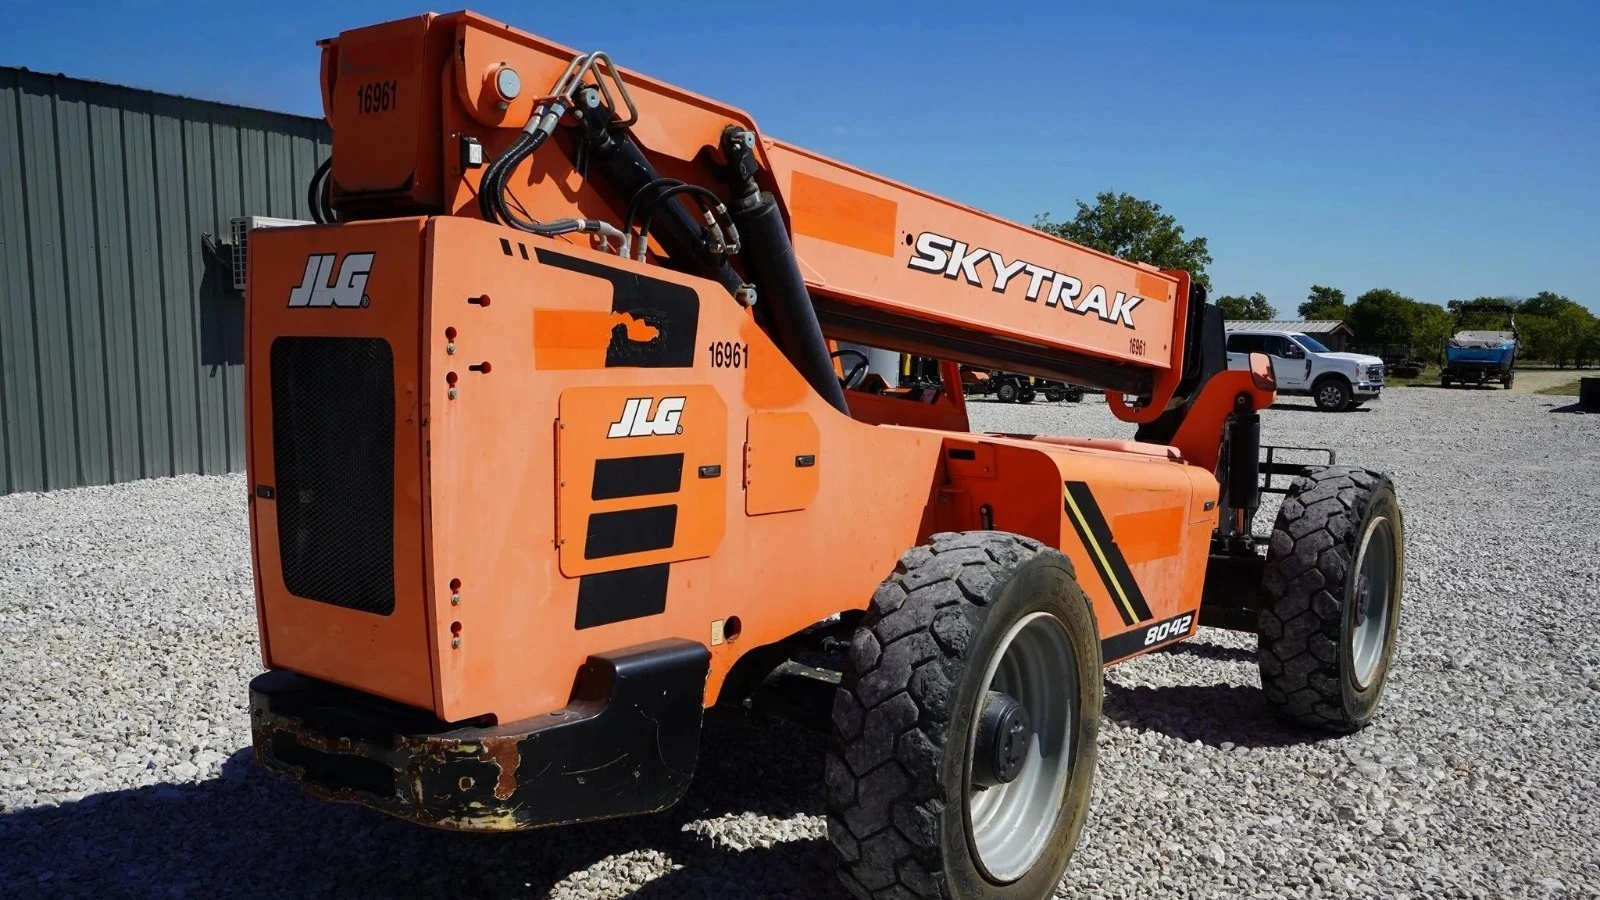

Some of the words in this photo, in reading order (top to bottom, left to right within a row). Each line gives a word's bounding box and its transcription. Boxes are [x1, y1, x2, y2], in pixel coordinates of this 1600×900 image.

[357, 80, 397, 114] 16961
[288, 252, 375, 308] JLG
[907, 231, 1143, 329] SKYTRAK
[708, 341, 748, 369] 16961
[1129, 337, 1147, 357] 16961
[608, 397, 685, 438] JLG
[1144, 615, 1193, 647] 8042
